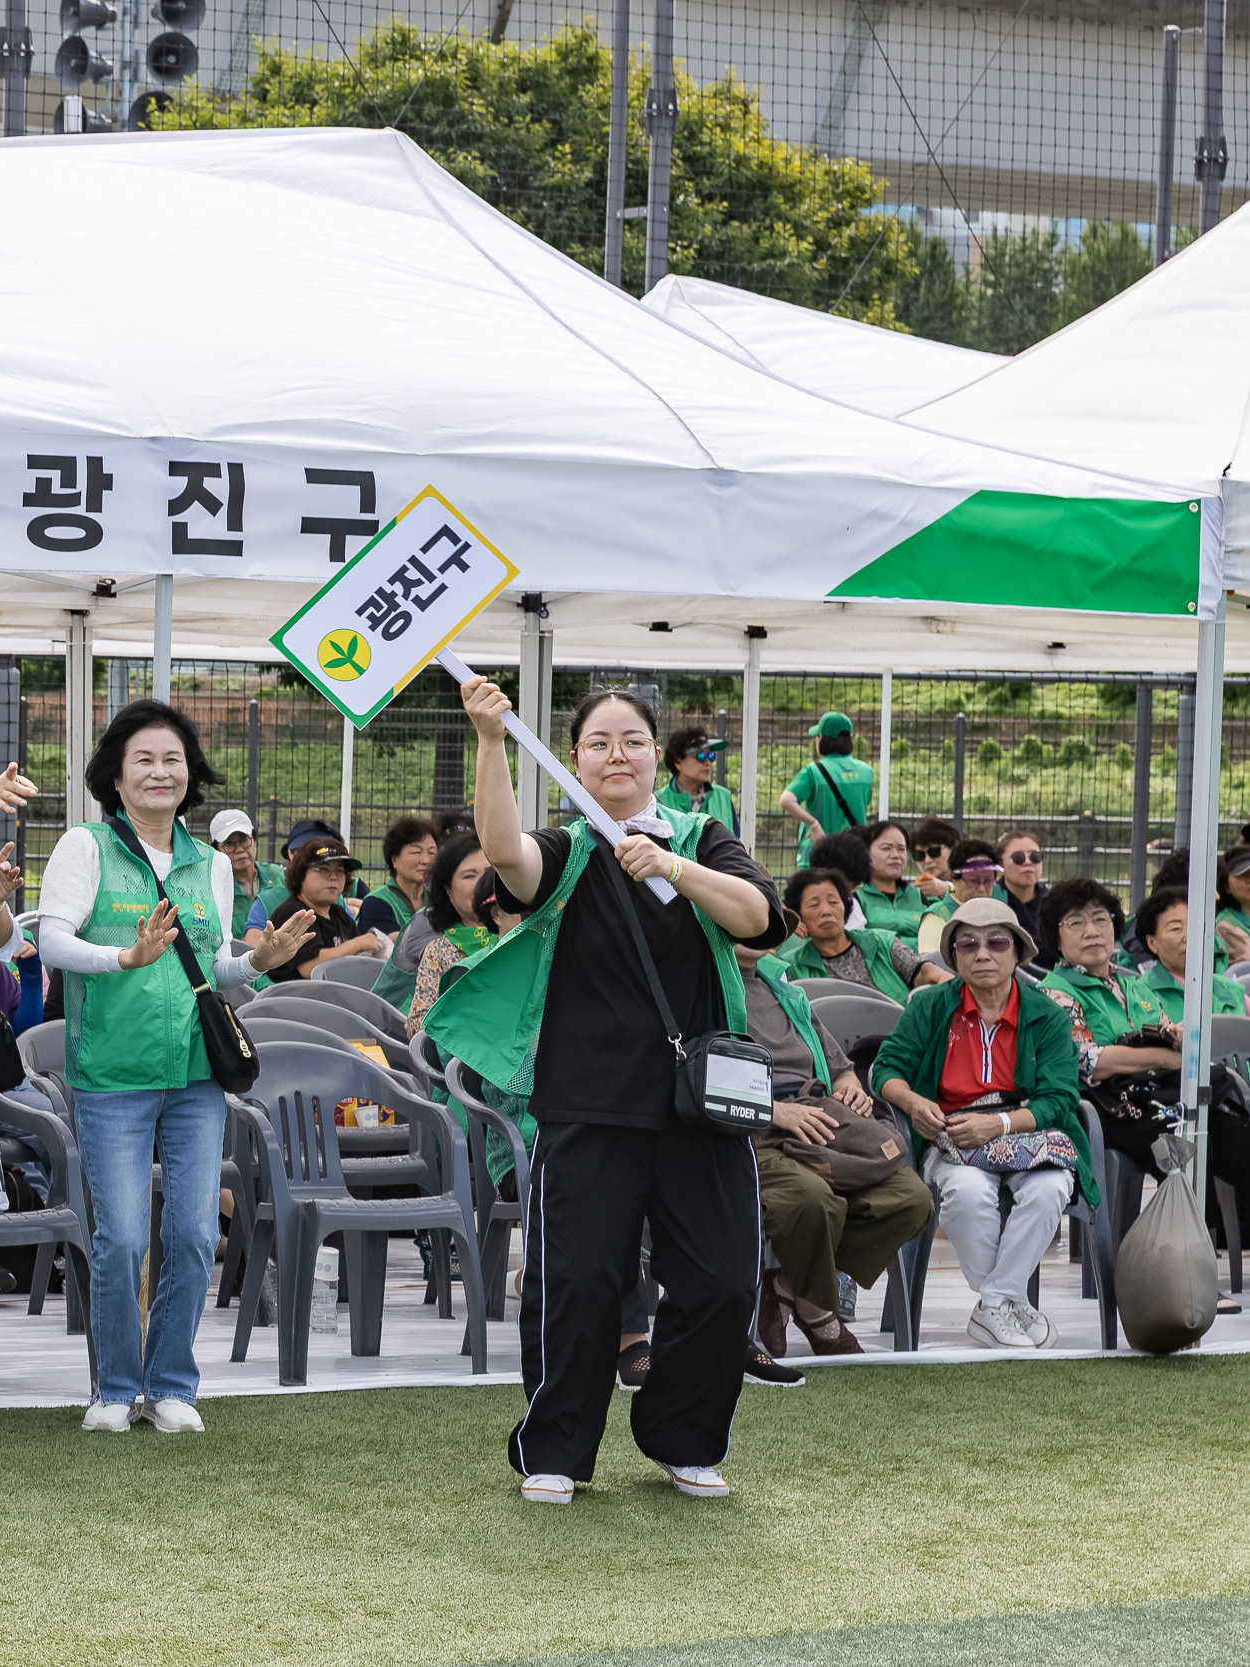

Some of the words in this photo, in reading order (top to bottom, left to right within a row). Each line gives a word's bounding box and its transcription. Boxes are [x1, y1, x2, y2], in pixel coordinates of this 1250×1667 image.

[355, 524, 472, 642] 광진구
[192, 918, 210, 928] SMU
[730, 1104, 756, 1120] RYDER
